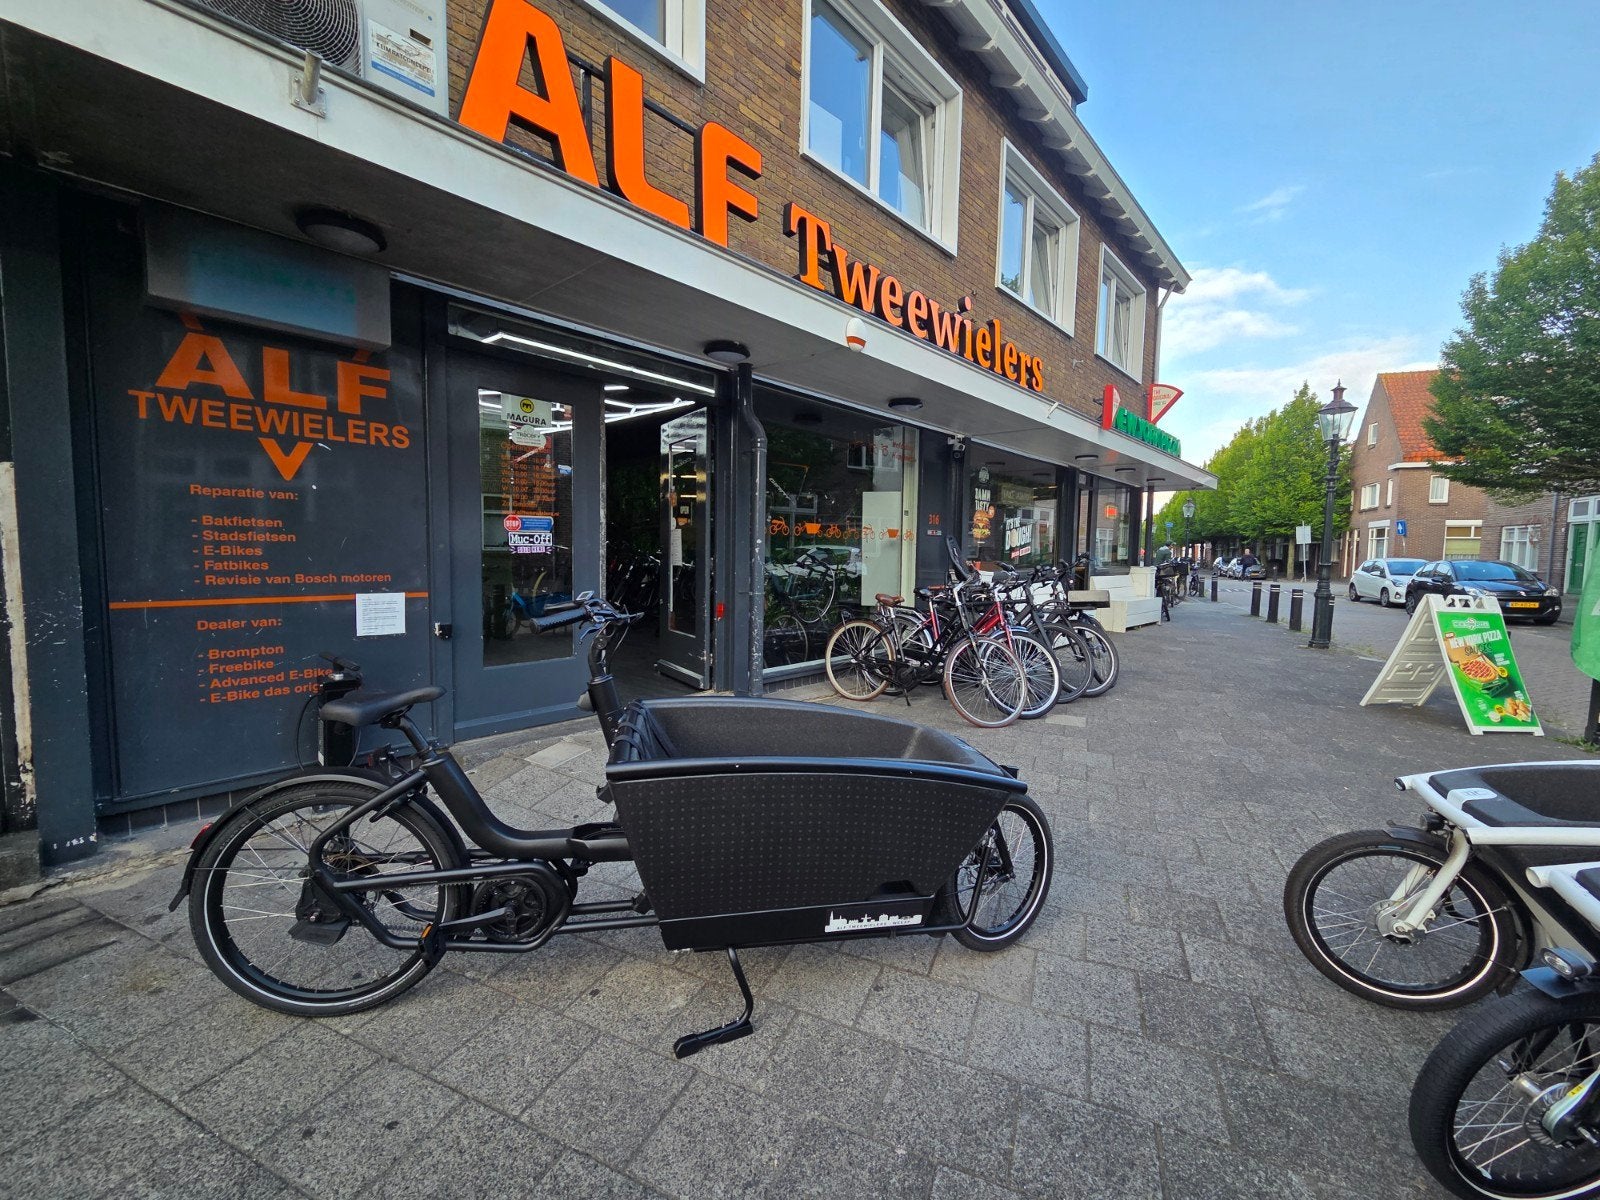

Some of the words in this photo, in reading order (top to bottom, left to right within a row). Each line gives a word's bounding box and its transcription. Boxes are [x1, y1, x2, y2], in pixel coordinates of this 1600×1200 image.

[455, 0, 762, 249] ALF
[784, 202, 1043, 392] Tweewielers
[155, 332, 391, 415] ALF
[128, 389, 410, 449] TWEEWIELERS
[506, 413, 547, 426] MAGURA
[190, 484, 265, 499] Reparatie
[269, 490, 299, 500] van:
[201, 515, 283, 528] Bakfietsen
[202, 530, 296, 542] Stadsfietsen
[510, 534, 551, 544] Muc-Off
[203, 545, 263, 556] E-Bikes
[204, 560, 269, 571] Fatbikes
[205, 574, 261, 585] Revisie
[266, 575, 291, 584] van
[295, 573, 336, 584] Bosch
[341, 573, 391, 583] motoren
[196, 619, 246, 631] Dealer
[251, 618, 282, 627] van:
[208, 645, 284, 659] Brompton
[209, 660, 274, 674] Freebike
[210, 672, 284, 688] Advanced
[289, 668, 333, 681] E-Bike
[210, 689, 260, 703] E-Bike
[264, 685, 290, 698] das
